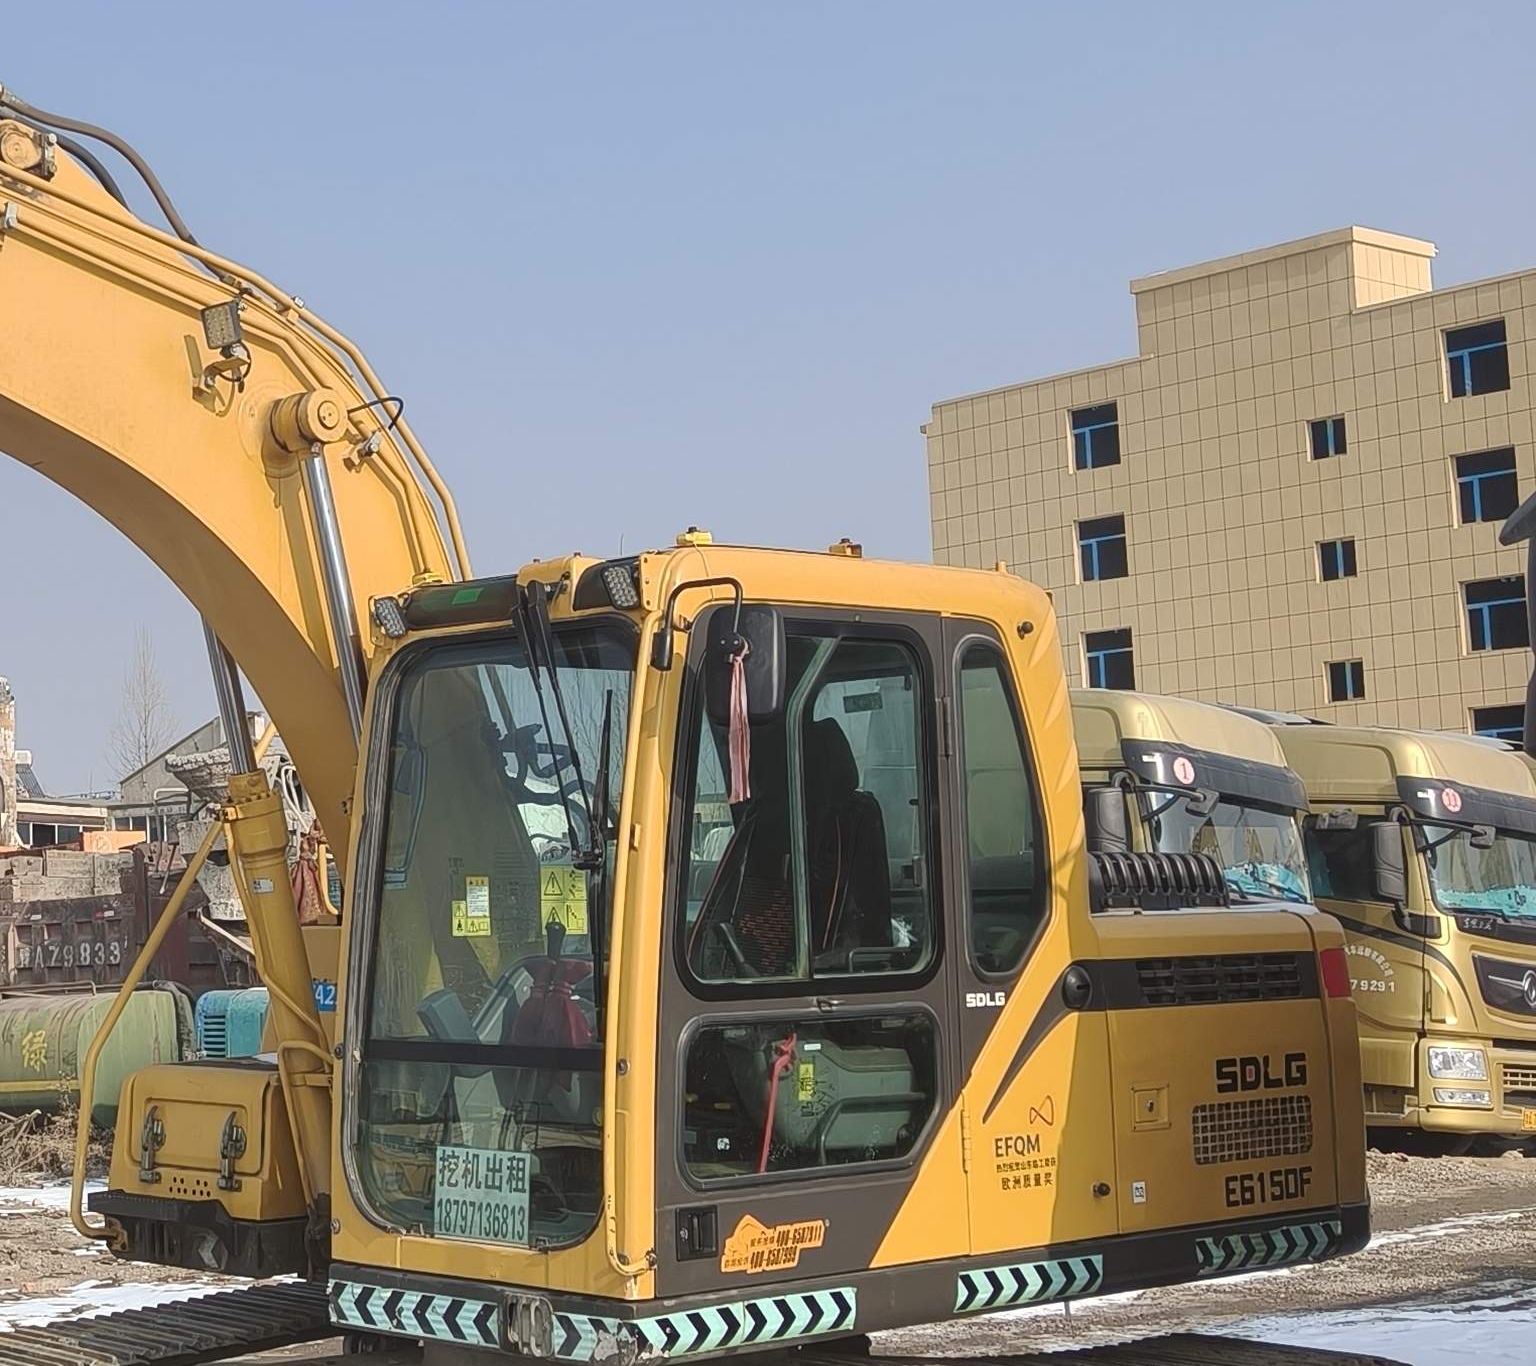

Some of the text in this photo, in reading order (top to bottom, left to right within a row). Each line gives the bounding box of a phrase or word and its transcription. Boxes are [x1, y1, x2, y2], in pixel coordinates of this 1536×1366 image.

[966, 991, 1006, 1008] SDLG
[1216, 1052, 1307, 1093] SDLG
[994, 1133, 1041, 1158] EFQM
[438, 1148, 527, 1194] 挖机出租
[1224, 1165, 1313, 1208] E6150F
[437, 1197, 526, 1241] 18797136813
